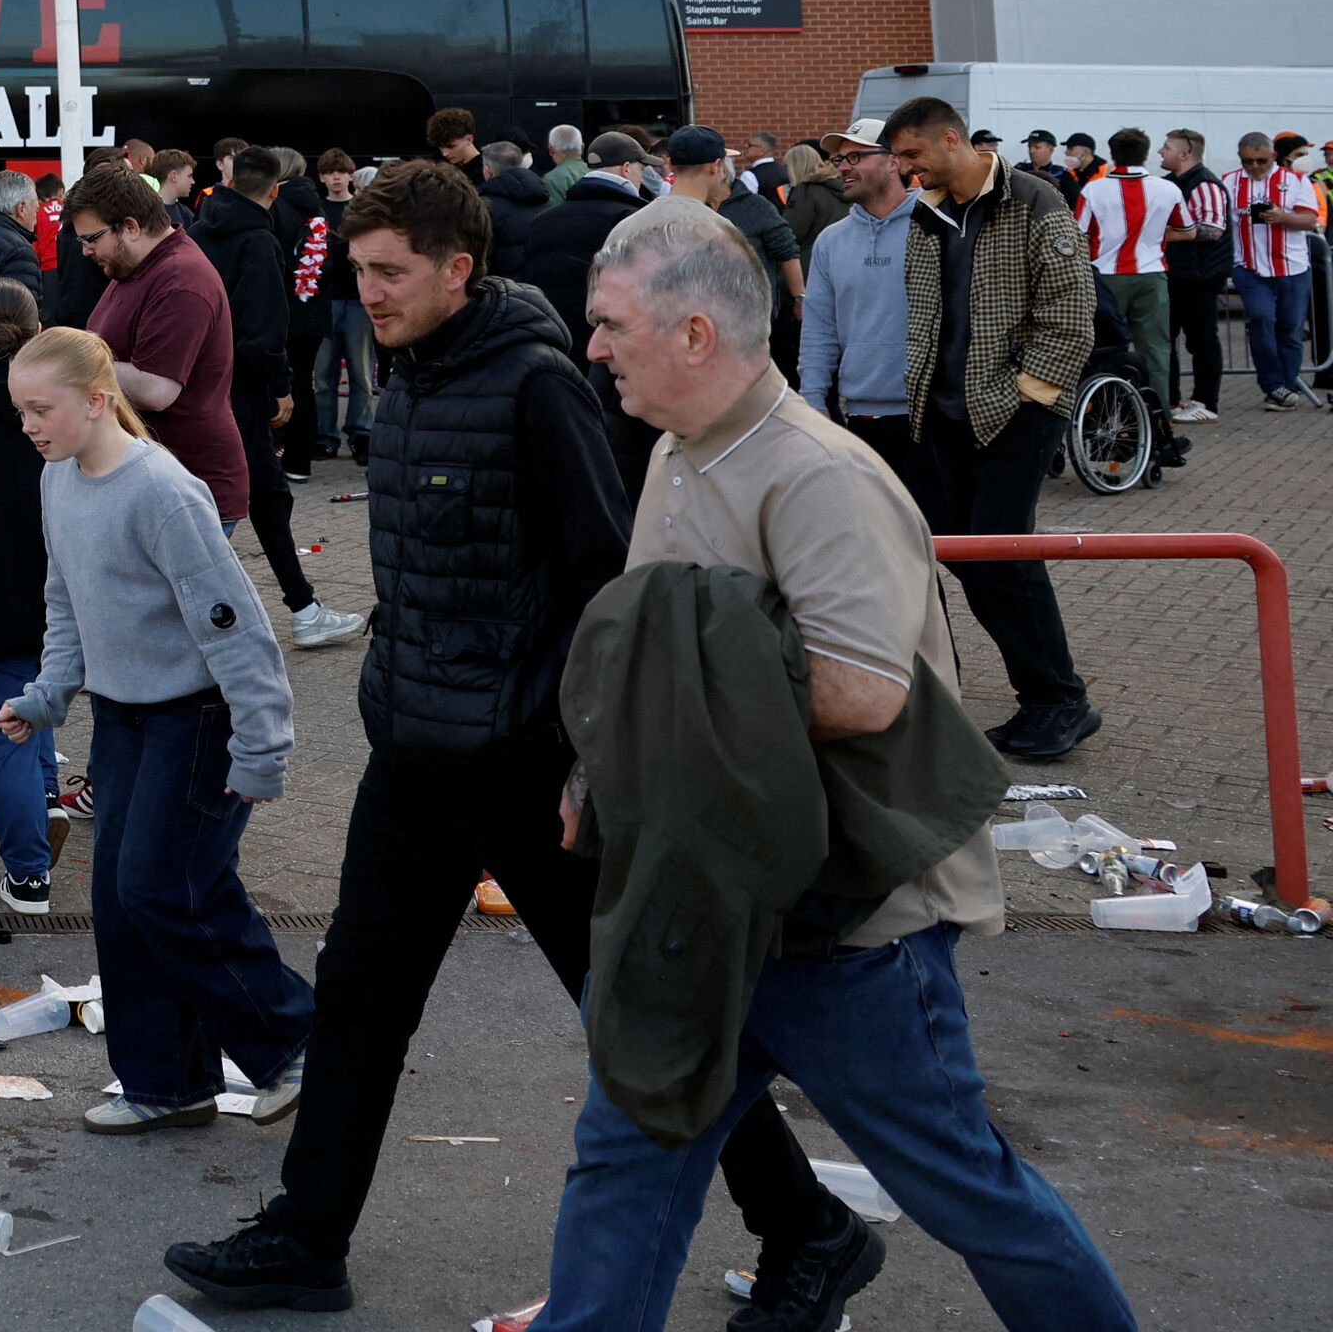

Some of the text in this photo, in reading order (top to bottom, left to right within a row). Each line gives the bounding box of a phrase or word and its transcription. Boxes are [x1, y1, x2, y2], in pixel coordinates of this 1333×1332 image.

[685, 6, 761, 15] Staplewood Lounge
[687, 17, 711, 25] Saints
